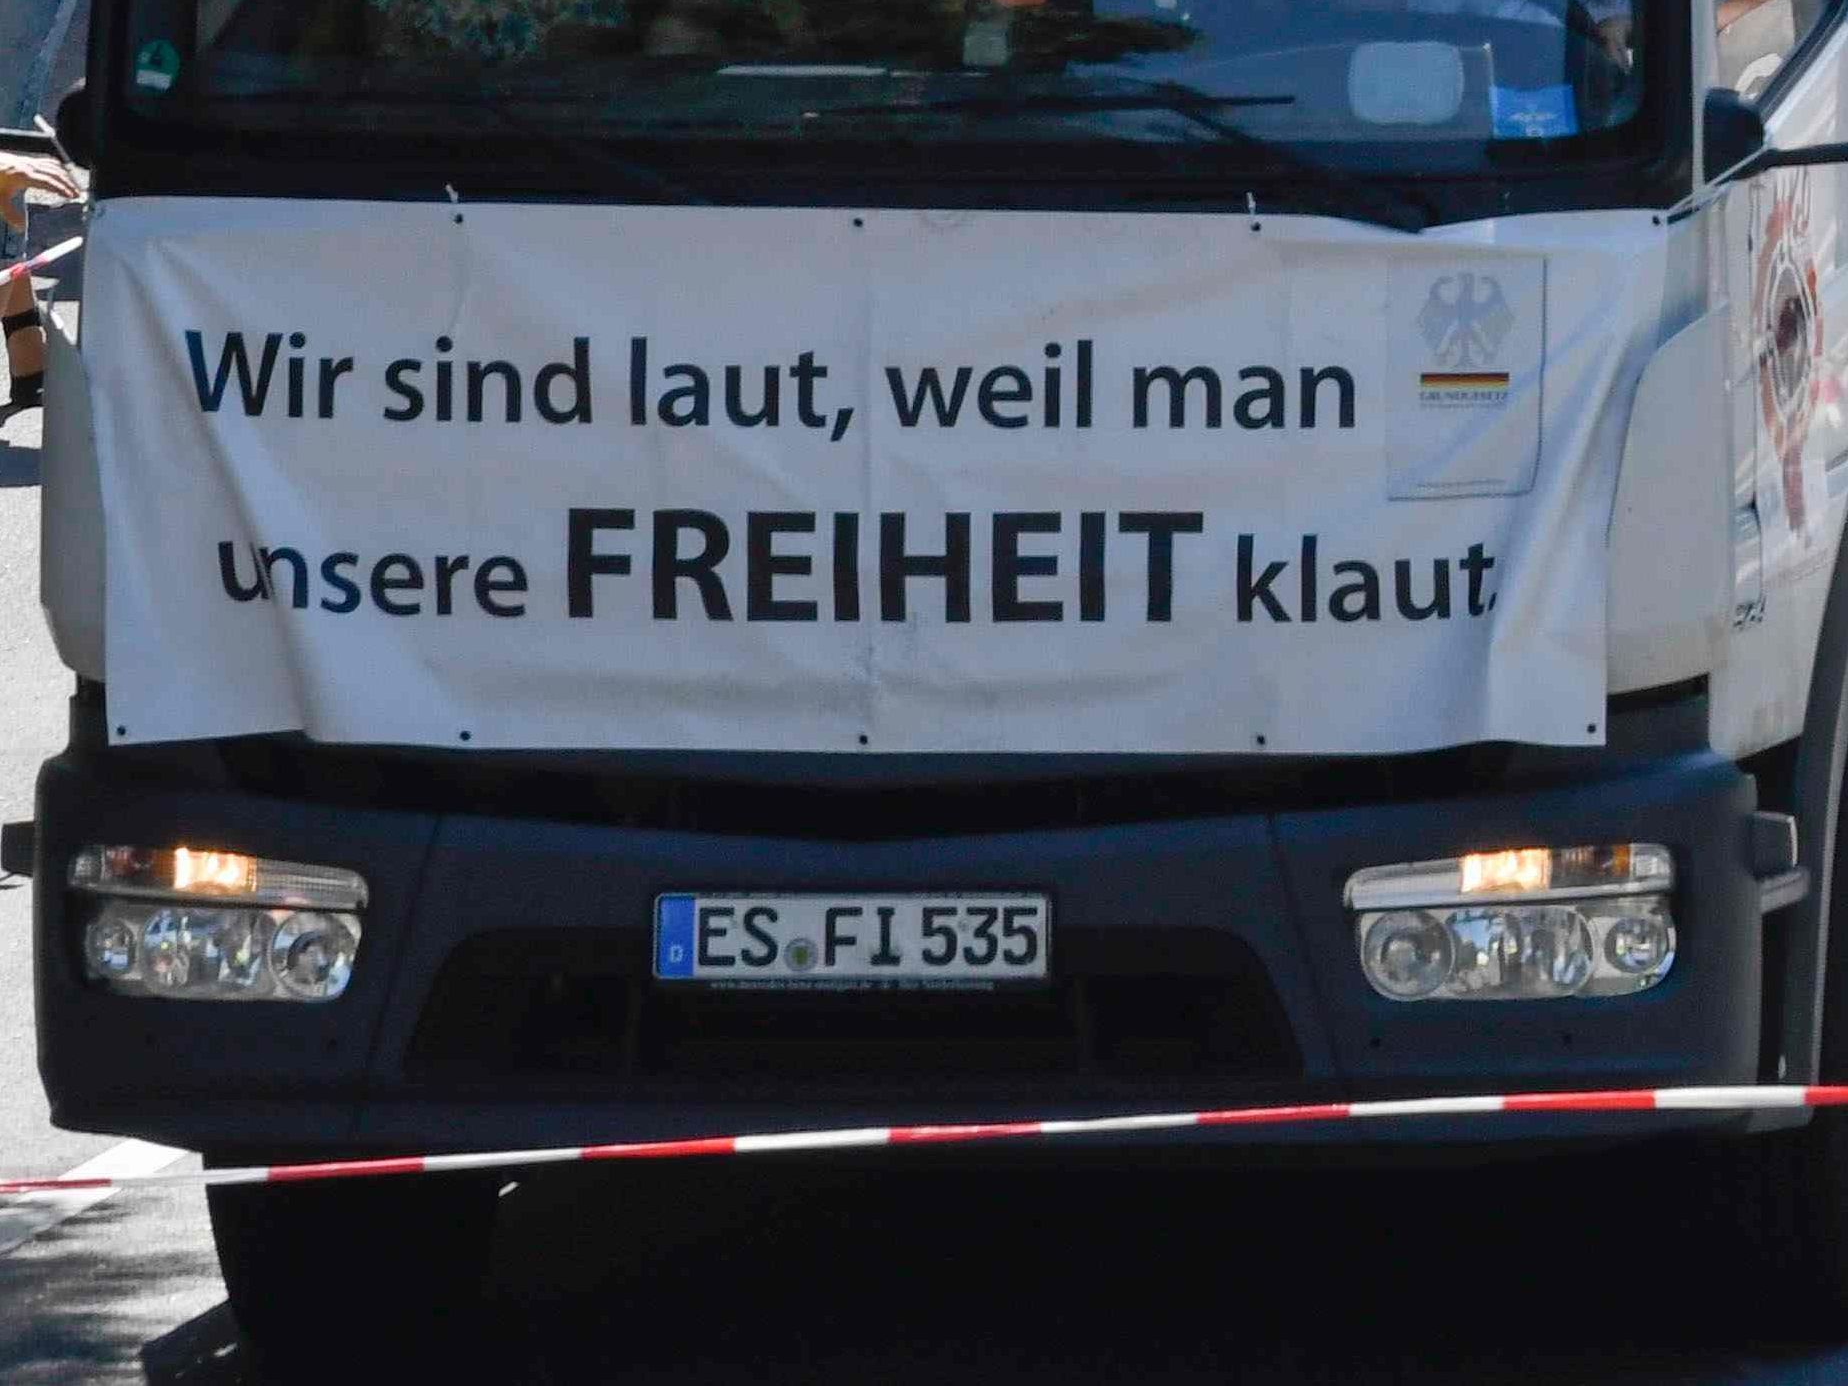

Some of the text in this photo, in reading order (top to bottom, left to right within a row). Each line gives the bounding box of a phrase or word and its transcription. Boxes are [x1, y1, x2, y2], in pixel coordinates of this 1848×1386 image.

[185, 330, 1356, 442] Wir sind laut, weil man
[217, 539, 529, 618] unsere
[567, 507, 1204, 624] FREIHEIT
[698, 906, 1039, 967] ES FI 535
